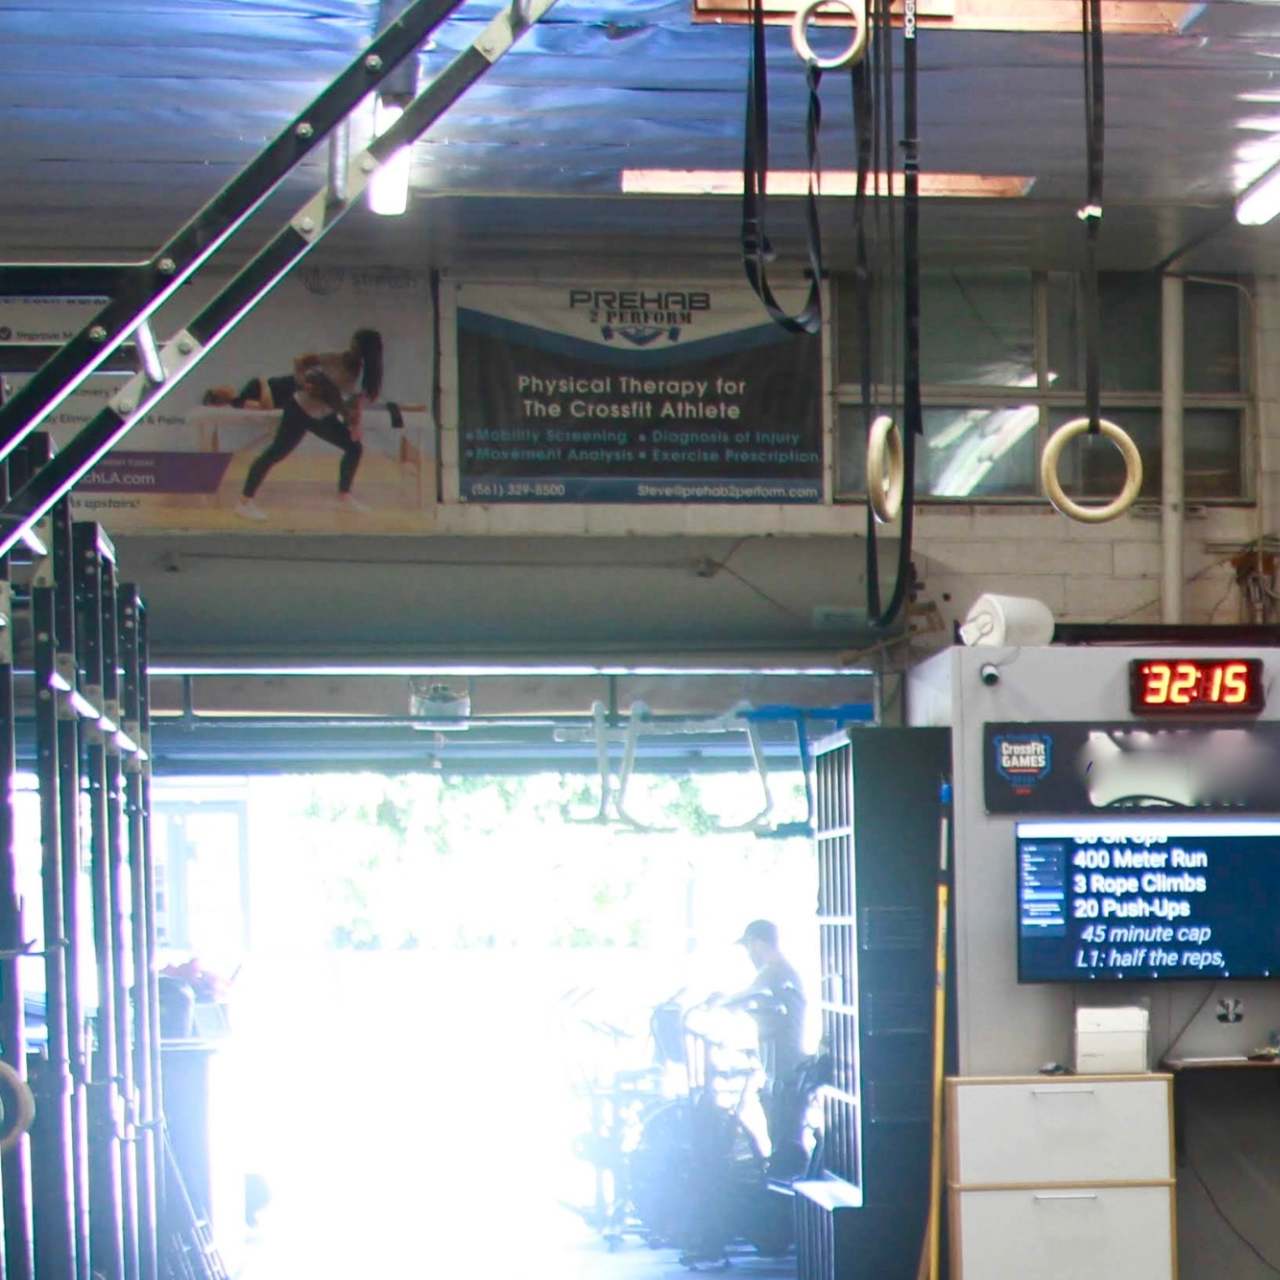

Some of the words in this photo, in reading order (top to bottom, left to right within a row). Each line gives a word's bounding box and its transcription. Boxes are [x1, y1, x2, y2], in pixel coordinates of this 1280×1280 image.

[569, 290, 711, 311] PREHAB
[606, 312, 692, 324] PERFORM
[518, 376, 611, 397] Physical
[619, 377, 708, 398] Therapy
[716, 377, 746, 395] for
[524, 401, 561, 417] The
[570, 401, 653, 418] Crossfit
[661, 402, 740, 419] Athlete
[476, 430, 541, 444] Mobility
[547, 430, 628, 445] Screening
[652, 431, 729, 446] Diagnosis
[735, 432, 750, 444] of
[756, 432, 800, 446] Injury
[476, 448, 561, 460] Movement
[567, 449, 634, 463] Analysis
[653, 450, 719, 462] Exercise
[726, 450, 820, 464] Prescription
[1144, 664, 1248, 703] 32:15
[1002, 755, 1046, 768] GAMES
[1074, 850, 1110, 869] 400
[1114, 849, 1167, 868] Meter
[1171, 849, 1208, 868] Run
[1074, 875, 1086, 893] 3
[1090, 875, 1138, 896] Rope
[1142, 873, 1206, 893] Climbs
[1074, 900, 1098, 918] 20
[1103, 898, 1190, 920] Push-Ups
[1081, 926, 1105, 943] 45
[1110, 925, 1174, 942] minute
[1178, 928, 1211, 948] cap
[1109, 949, 1146, 967] half
[1149, 949, 1179, 966] the
[1183, 951, 1226, 971] reps,
